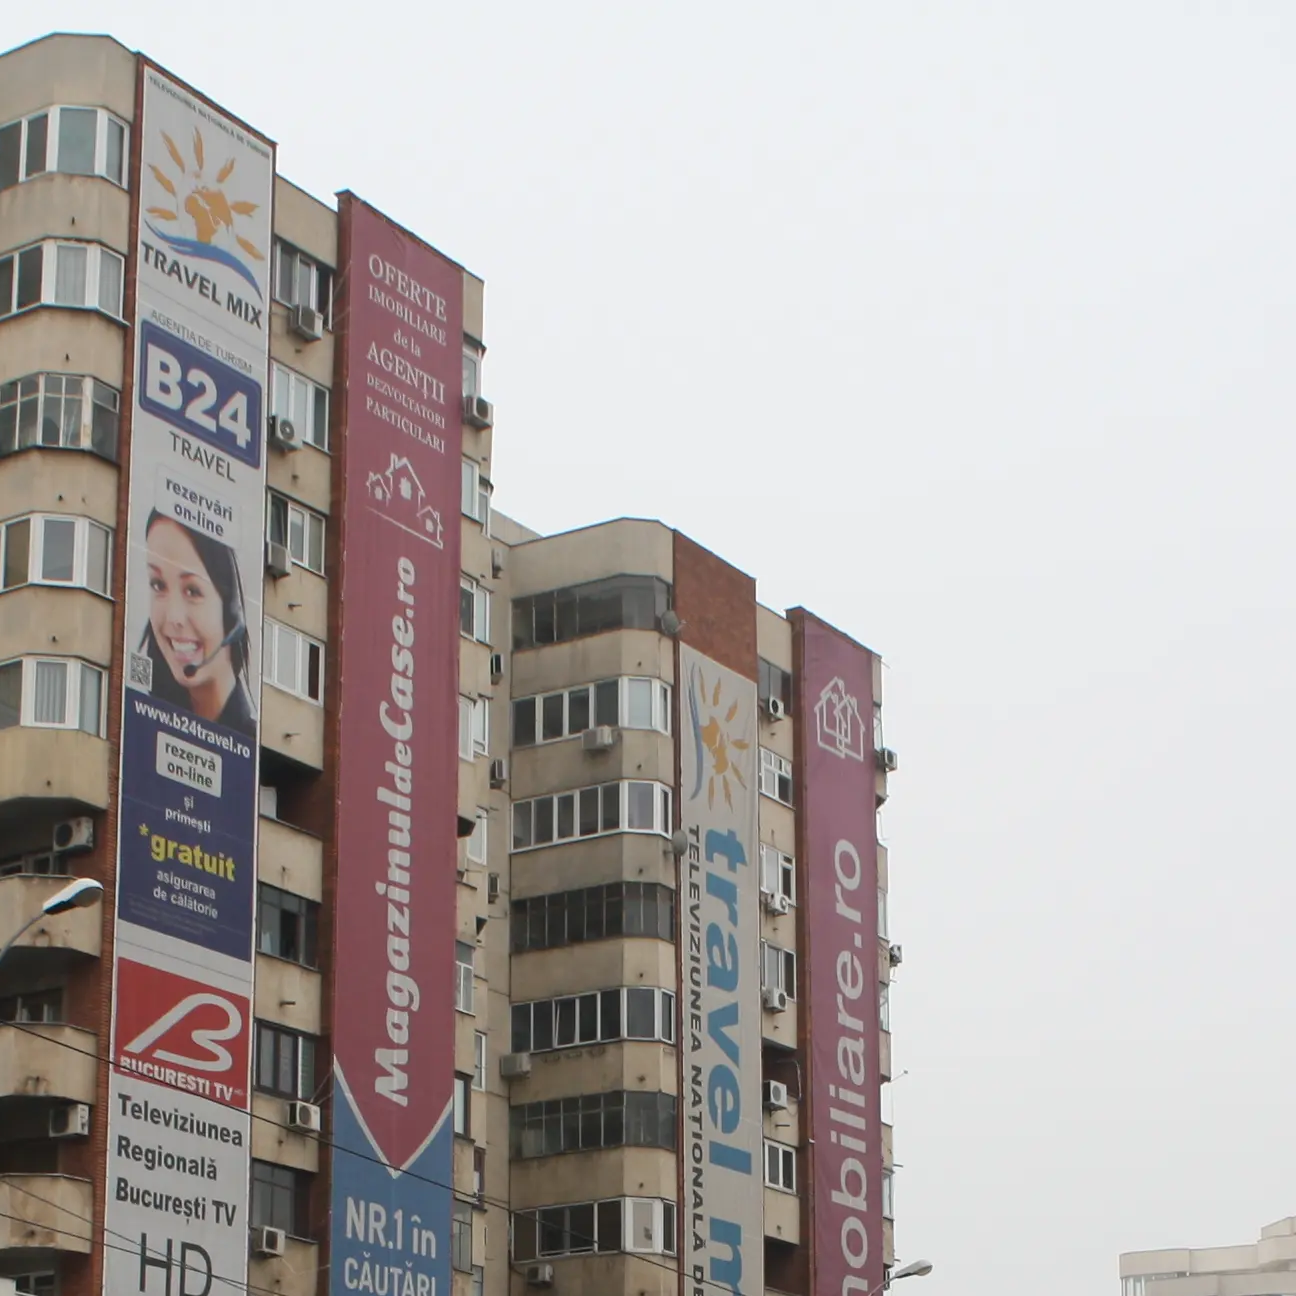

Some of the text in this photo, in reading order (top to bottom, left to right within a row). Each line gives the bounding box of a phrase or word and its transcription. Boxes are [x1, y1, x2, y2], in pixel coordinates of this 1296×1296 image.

[141, 241, 263, 331] TRAVEL MIX
[368, 253, 447, 323] OFERTE
[368, 283, 447, 347] IMOBILIARE
[198, 335, 212, 353] DE
[215, 344, 253, 375] TURISM
[393, 327, 421, 359] de la
[145, 342, 252, 450] B24
[366, 372, 445, 430] DEZVOLTATORI
[365, 396, 445, 454] PARTICULARI
[169, 431, 236, 483] TRAVEL
[165, 476, 234, 523] rezervări
[173, 502, 225, 538] on-line
[134, 699, 252, 760] www.b24travel.ro
[164, 741, 217, 773] rezervă
[166, 760, 214, 790] on-line
[164, 806, 212, 835] primești
[153, 886, 168, 902] de
[170, 891, 220, 920] călătorie
[156, 868, 217, 901] asigurarea
[686, 825, 703, 1053] TELEVIZIUNEA
[704, 826, 752, 1177] travel
[119, 1055, 234, 1101] BUCURESTI TV
[117, 1092, 244, 1148] Televiziunea
[116, 1135, 218, 1182] Regională
[687, 1064, 706, 1252] NAȚIONALĂ
[115, 1177, 237, 1227] București TV
[345, 1196, 437, 1259] NR.1 în
